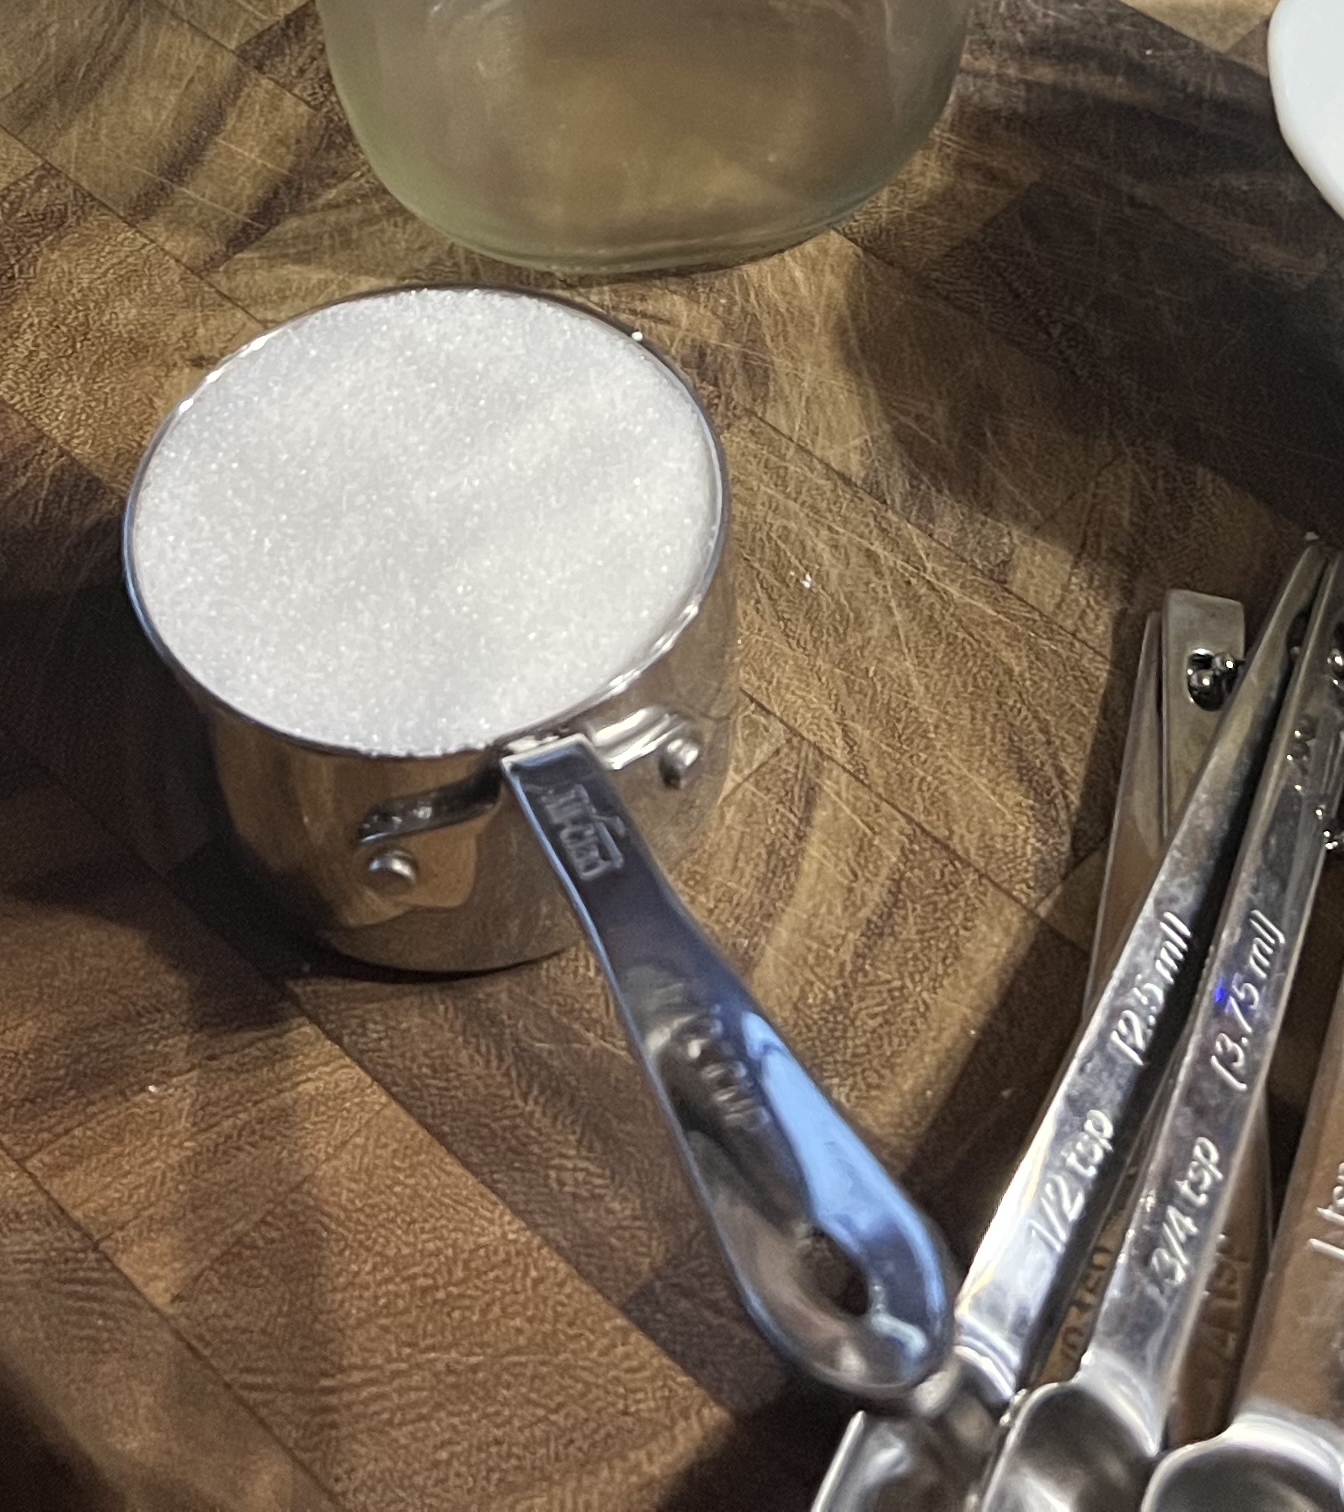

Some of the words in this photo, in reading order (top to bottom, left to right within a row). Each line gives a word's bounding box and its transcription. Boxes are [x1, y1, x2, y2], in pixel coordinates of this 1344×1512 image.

[1028, 1175, 1084, 1253] 1/2
[1061, 1109, 1114, 1178] tsp
[1151, 1205, 1199, 1286] 3/4
[1175, 1136, 1223, 1207] tsp
